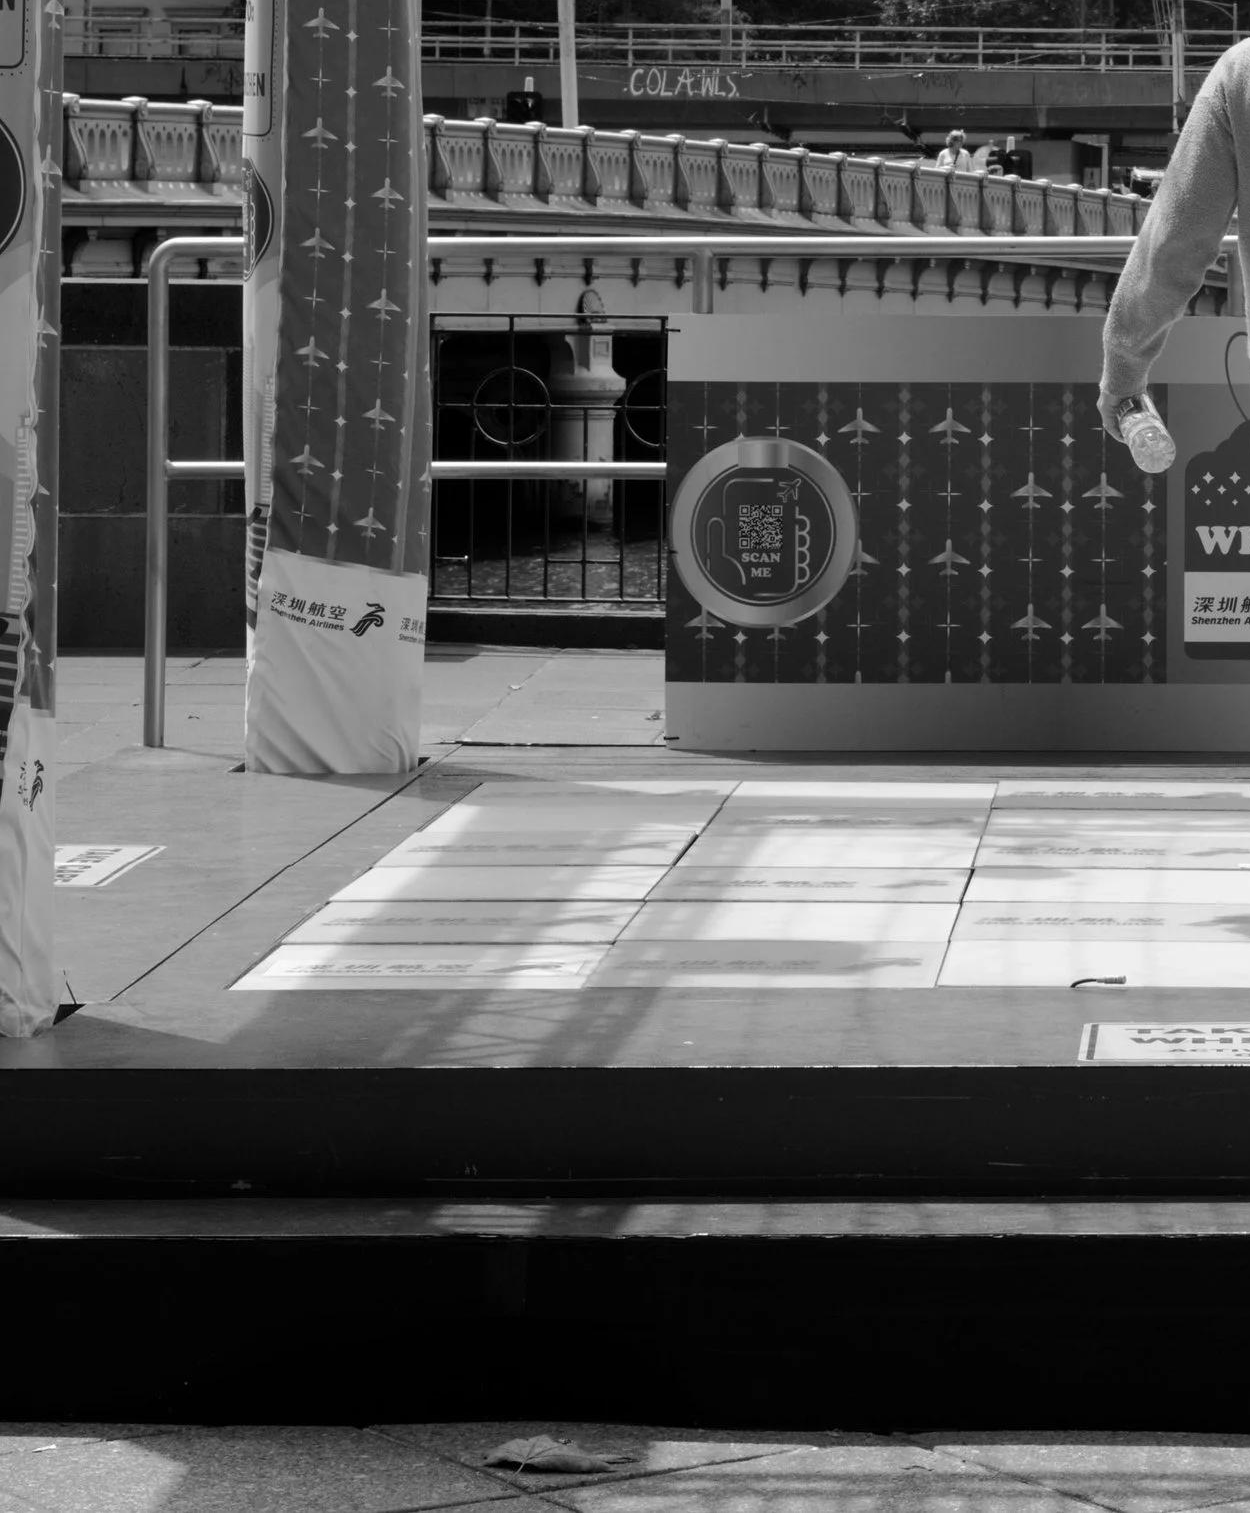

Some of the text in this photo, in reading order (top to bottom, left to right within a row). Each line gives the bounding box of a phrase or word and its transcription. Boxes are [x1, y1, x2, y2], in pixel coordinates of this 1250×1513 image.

[741, 552, 780, 563] SCAN
[751, 567, 771, 577] ME
[271, 591, 347, 622] 深圳航空
[270, 605, 345, 631] Shenzhen Airlines
[1191, 616, 1241, 625] Shenzhen
